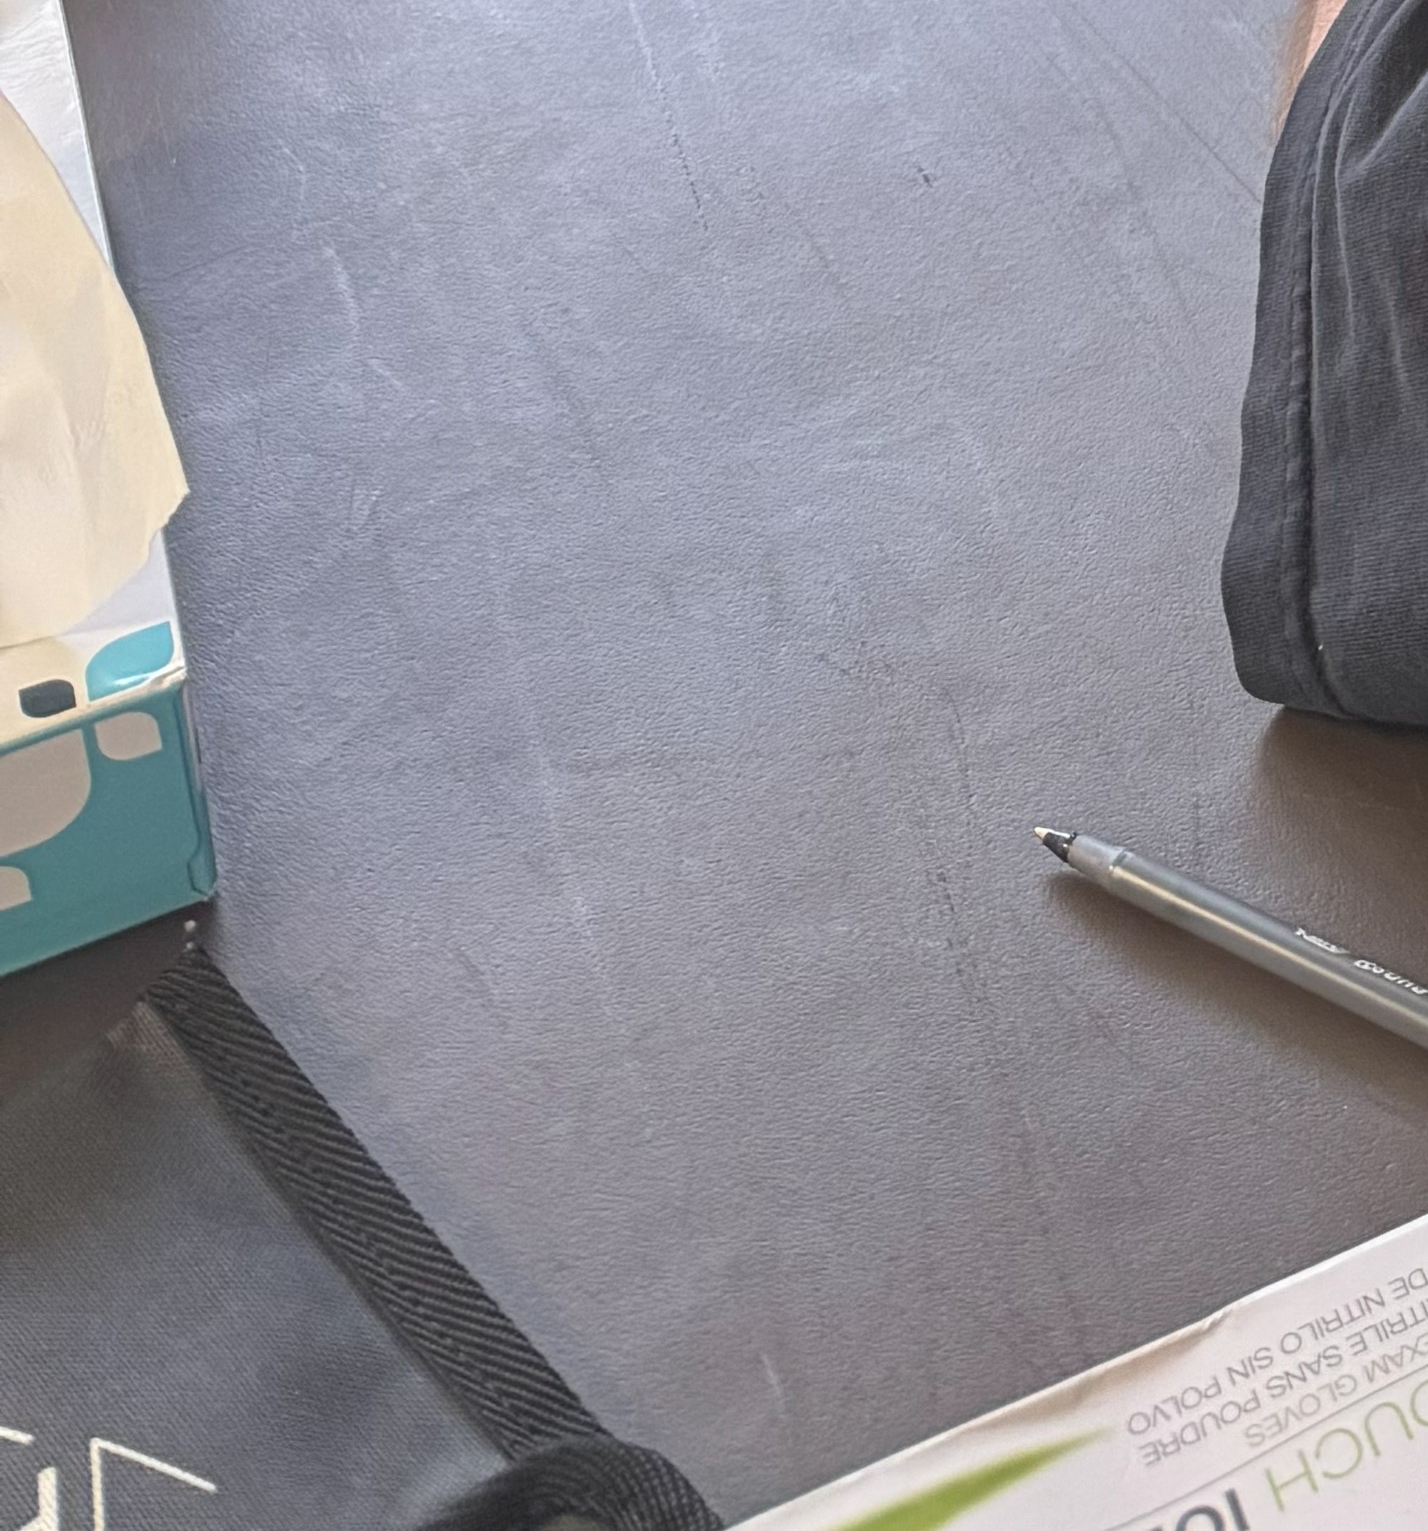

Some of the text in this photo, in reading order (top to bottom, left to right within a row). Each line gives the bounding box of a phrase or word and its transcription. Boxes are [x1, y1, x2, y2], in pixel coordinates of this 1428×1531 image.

[1275, 1287, 1389, 1358] NITRILO
[1222, 1343, 1277, 1386] SIN
[1260, 1342, 1347, 1401] SANS
[1123, 1373, 1222, 1438] POLVO
[1136, 1388, 1262, 1468] POUDRE
[1241, 1369, 1360, 1448] GLOVES
